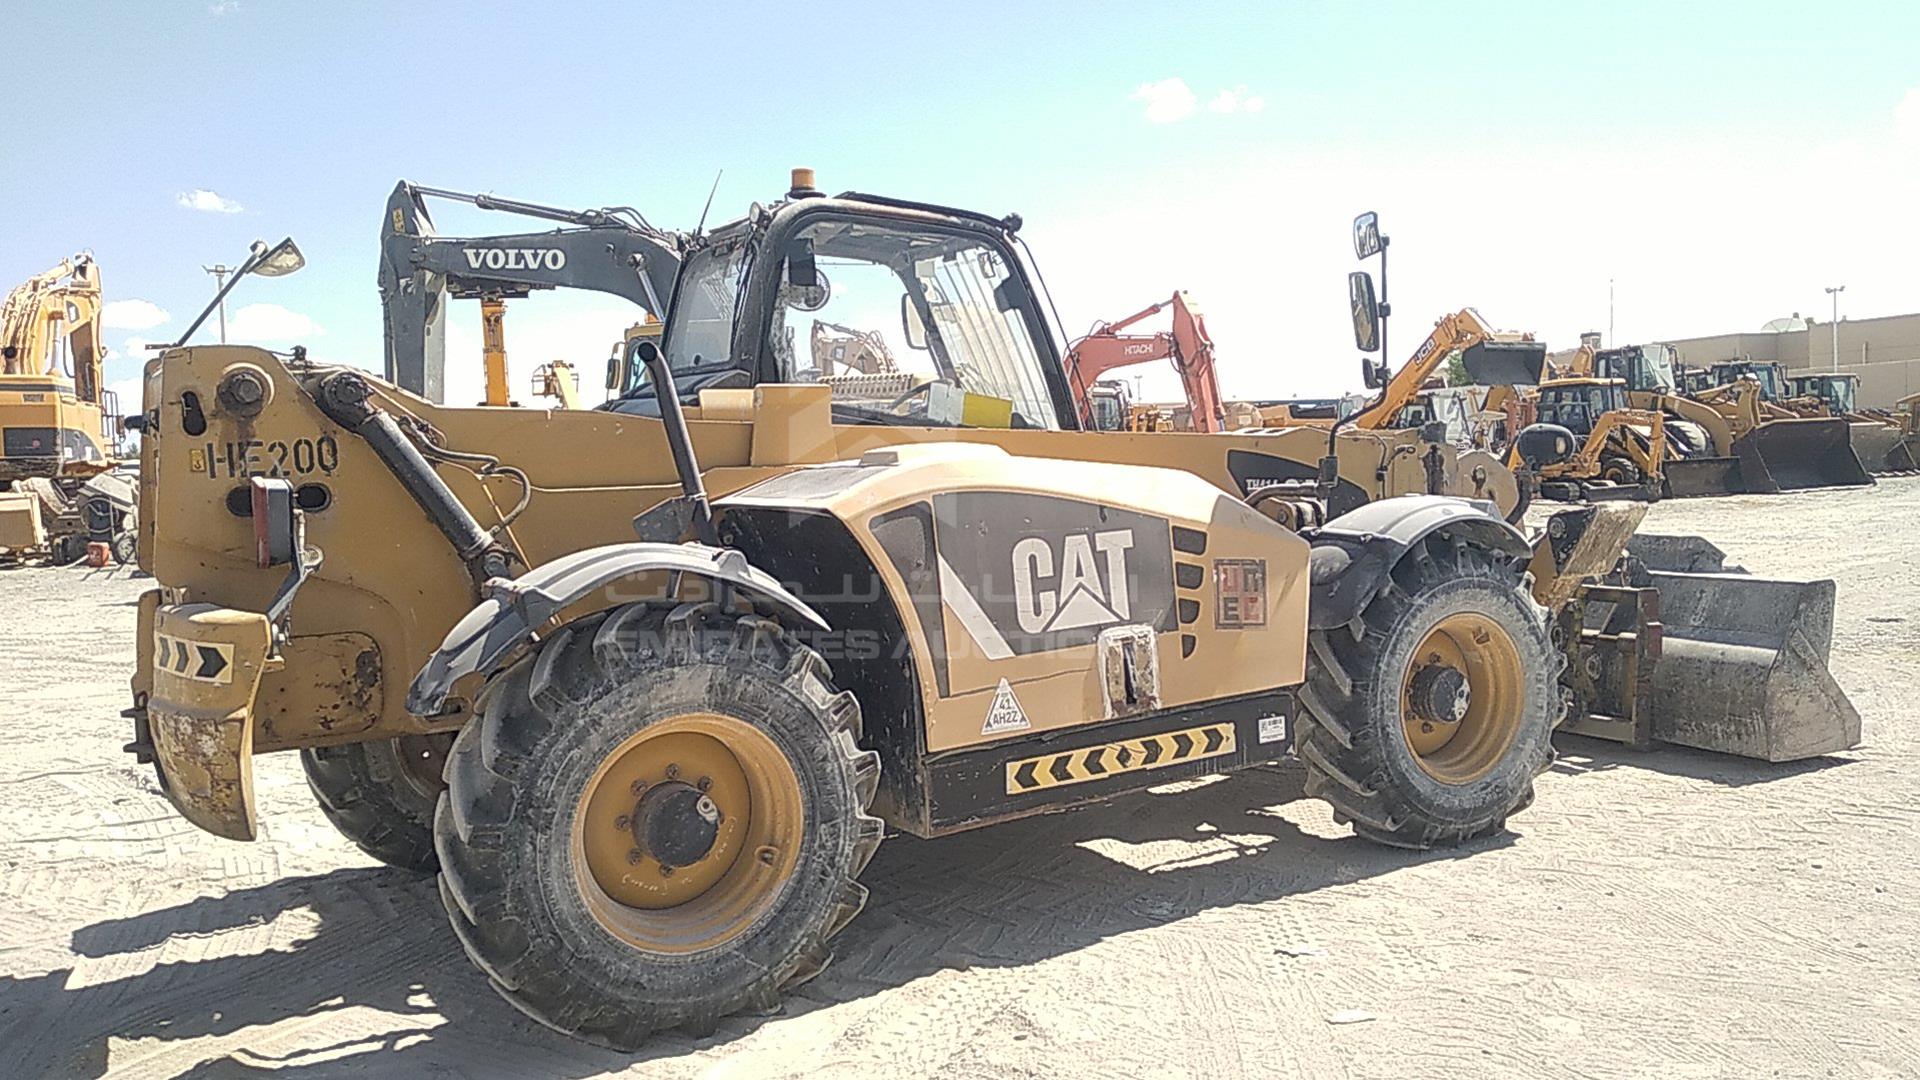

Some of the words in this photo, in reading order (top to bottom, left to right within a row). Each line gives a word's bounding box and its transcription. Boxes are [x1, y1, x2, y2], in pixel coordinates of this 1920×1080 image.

[463, 248, 565, 270] VOLVO
[1124, 343, 1154, 355] HITACHI
[1414, 338, 1435, 366] JCB
[1012, 529, 1134, 633] CAT
[999, 698, 1011, 710] 41
